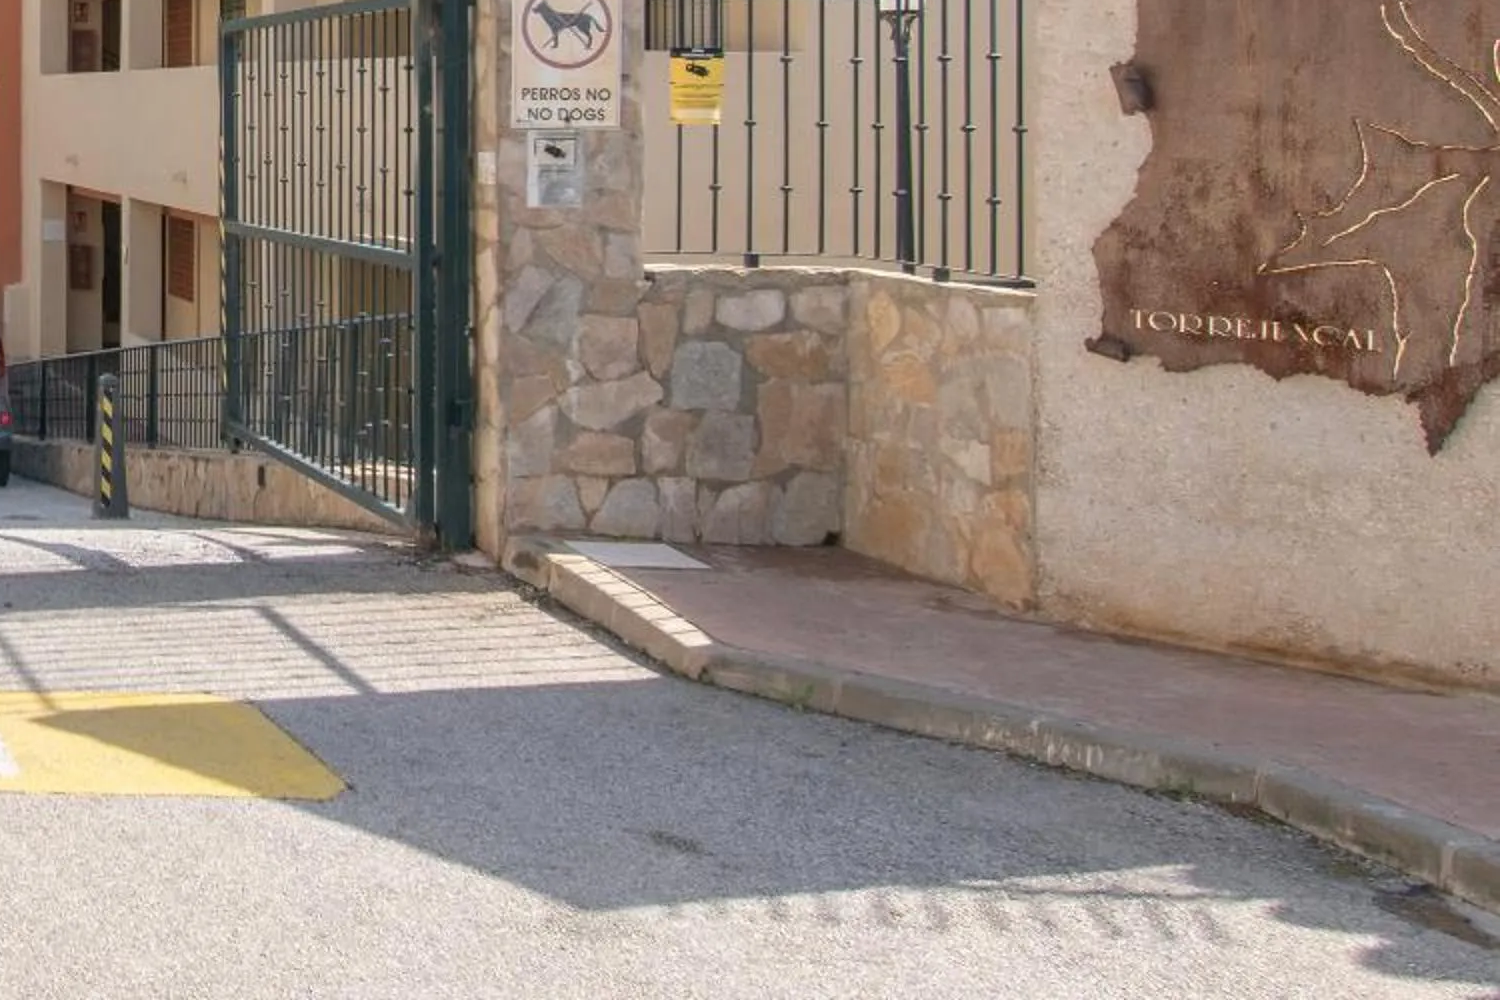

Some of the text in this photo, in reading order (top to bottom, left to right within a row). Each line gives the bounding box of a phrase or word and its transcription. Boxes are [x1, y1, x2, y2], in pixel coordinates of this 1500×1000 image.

[521, 87, 611, 101] PERROS NO
[527, 107, 606, 121] NO DOGS
